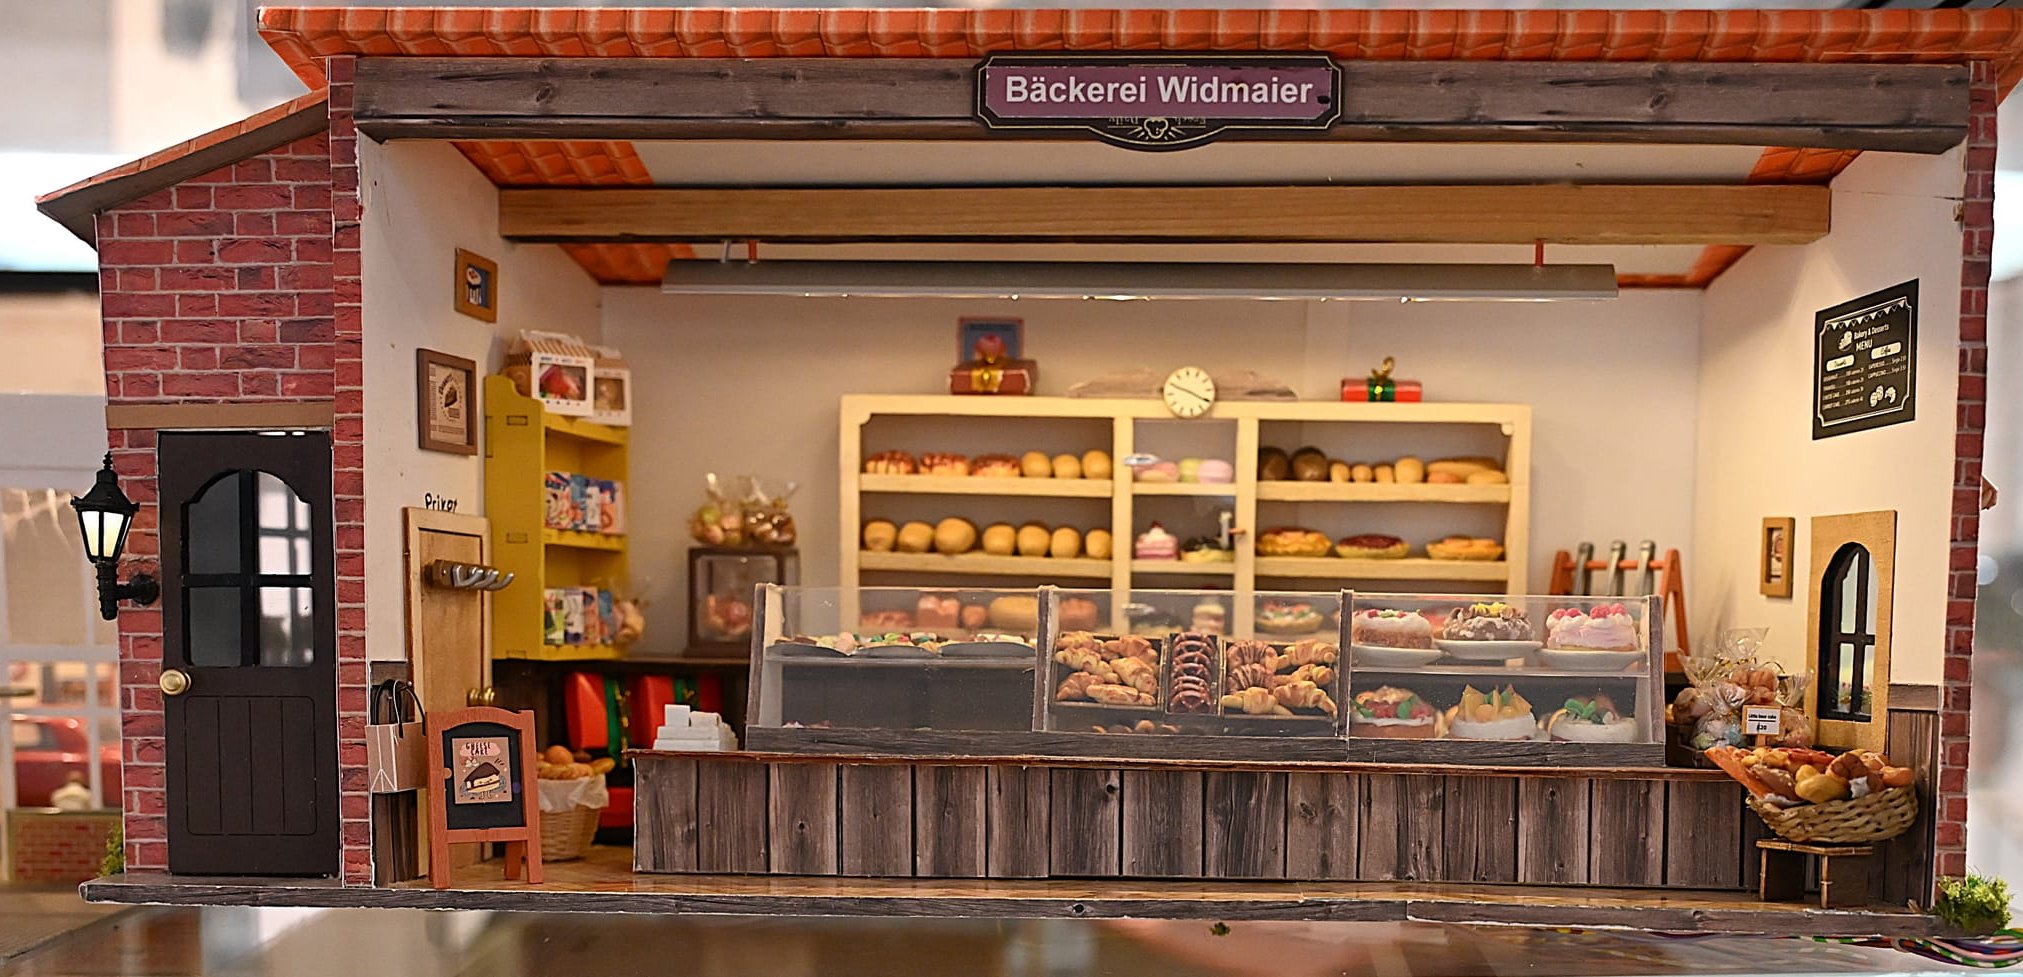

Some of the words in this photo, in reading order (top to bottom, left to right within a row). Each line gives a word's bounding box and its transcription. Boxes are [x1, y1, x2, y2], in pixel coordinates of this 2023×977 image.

[1005, 76, 1147, 103] Bäckerei
[1157, 76, 1313, 104] Widmaier
[1856, 338, 1872, 351] MENU
[470, 748, 488, 756] CAKE
